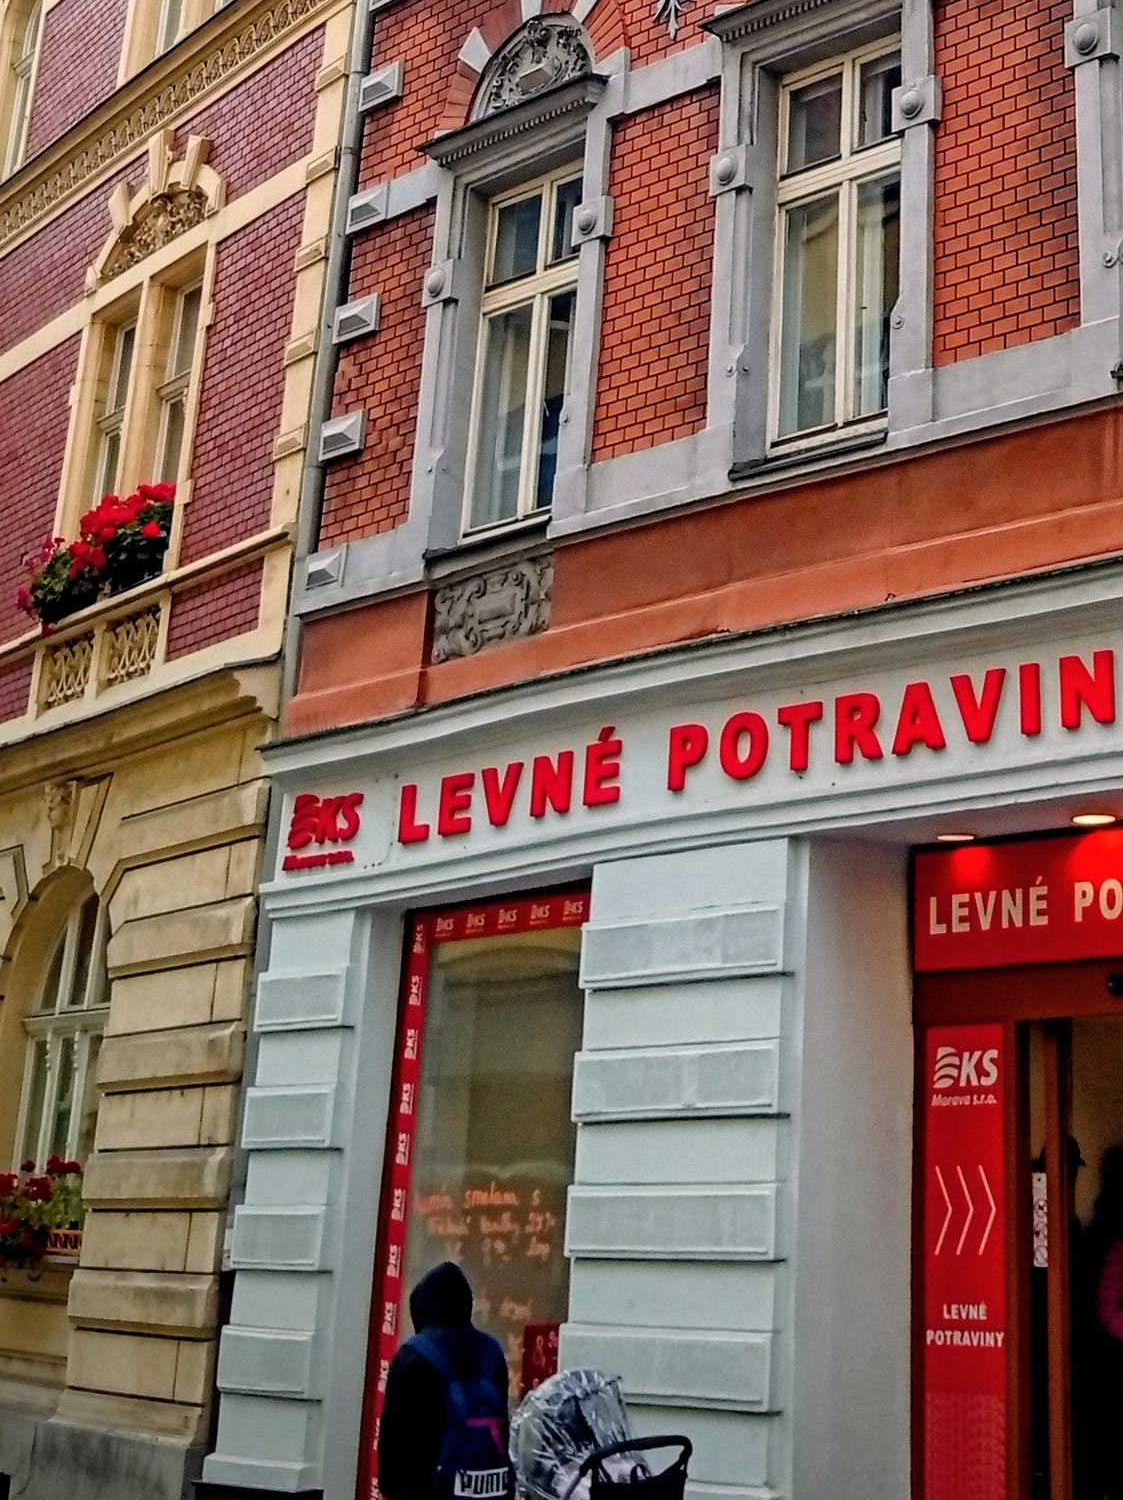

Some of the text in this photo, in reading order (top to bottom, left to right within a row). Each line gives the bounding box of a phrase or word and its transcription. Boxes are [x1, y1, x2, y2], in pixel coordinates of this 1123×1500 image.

[397, 726, 623, 844] LEVNÉ
[929, 876, 1049, 935] LEVNÉ
[943, 1299, 988, 1321] LEVNÉ
[926, 1329, 1005, 1348] POTRAVINY
